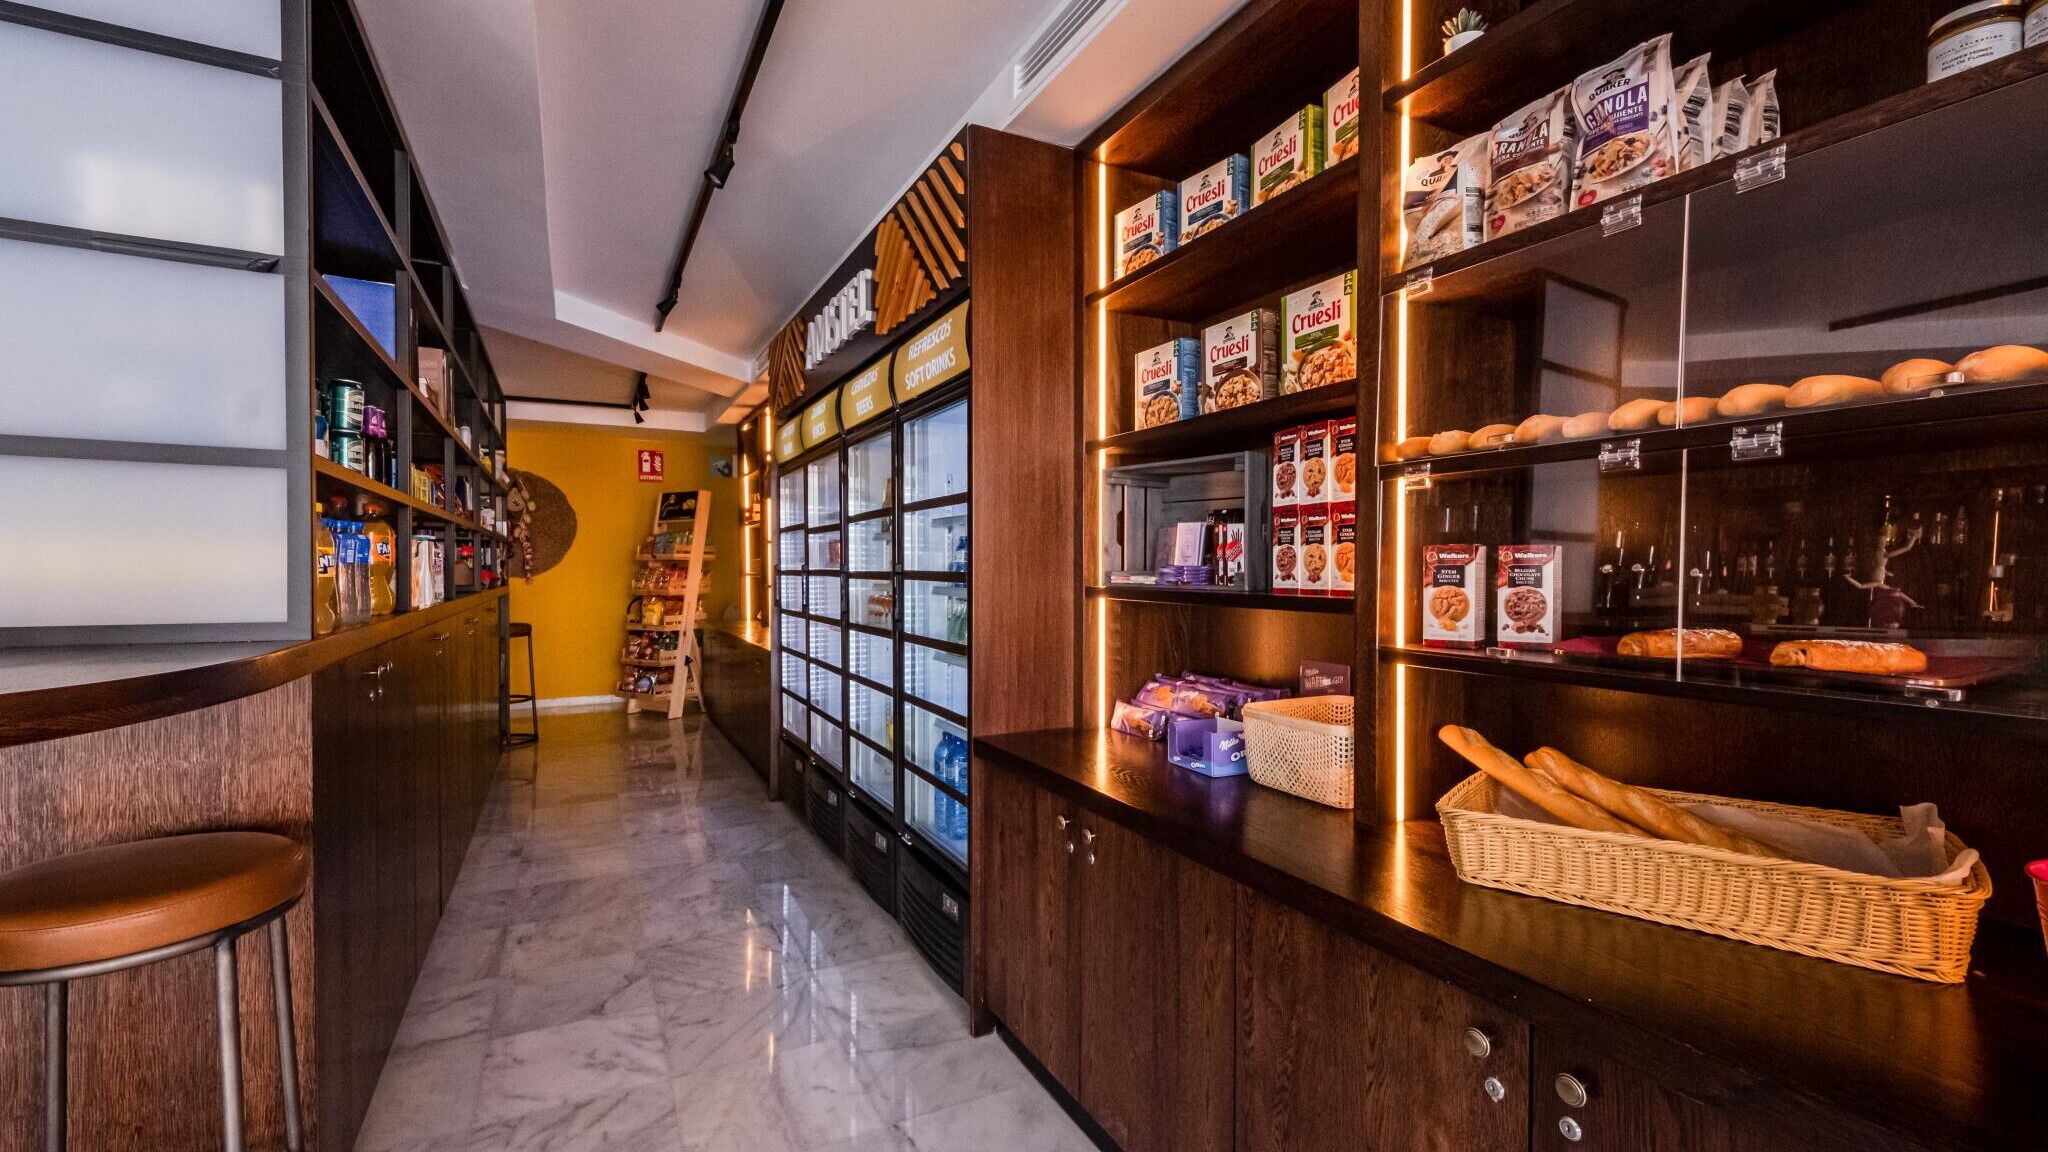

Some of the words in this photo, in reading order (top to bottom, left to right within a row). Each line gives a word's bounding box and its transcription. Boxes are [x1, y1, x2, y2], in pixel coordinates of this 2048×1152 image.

[1589, 78, 1631, 101] QUAKER
[1332, 94, 1360, 127] Crue
[1586, 85, 1648, 130] GRANOLA
[1259, 133, 1297, 177] Cruesli
[1186, 179, 1225, 213] Cruesli
[1122, 213, 1155, 243] Cruesli
[1292, 298, 1342, 335] Cruesli
[908, 318, 953, 360] REFRESCOS
[1210, 334, 1249, 364] Cruesli
[904, 366, 926, 391] SOFT
[925, 346, 956, 382] DRINKS
[1141, 359, 1172, 384] Cruesli
